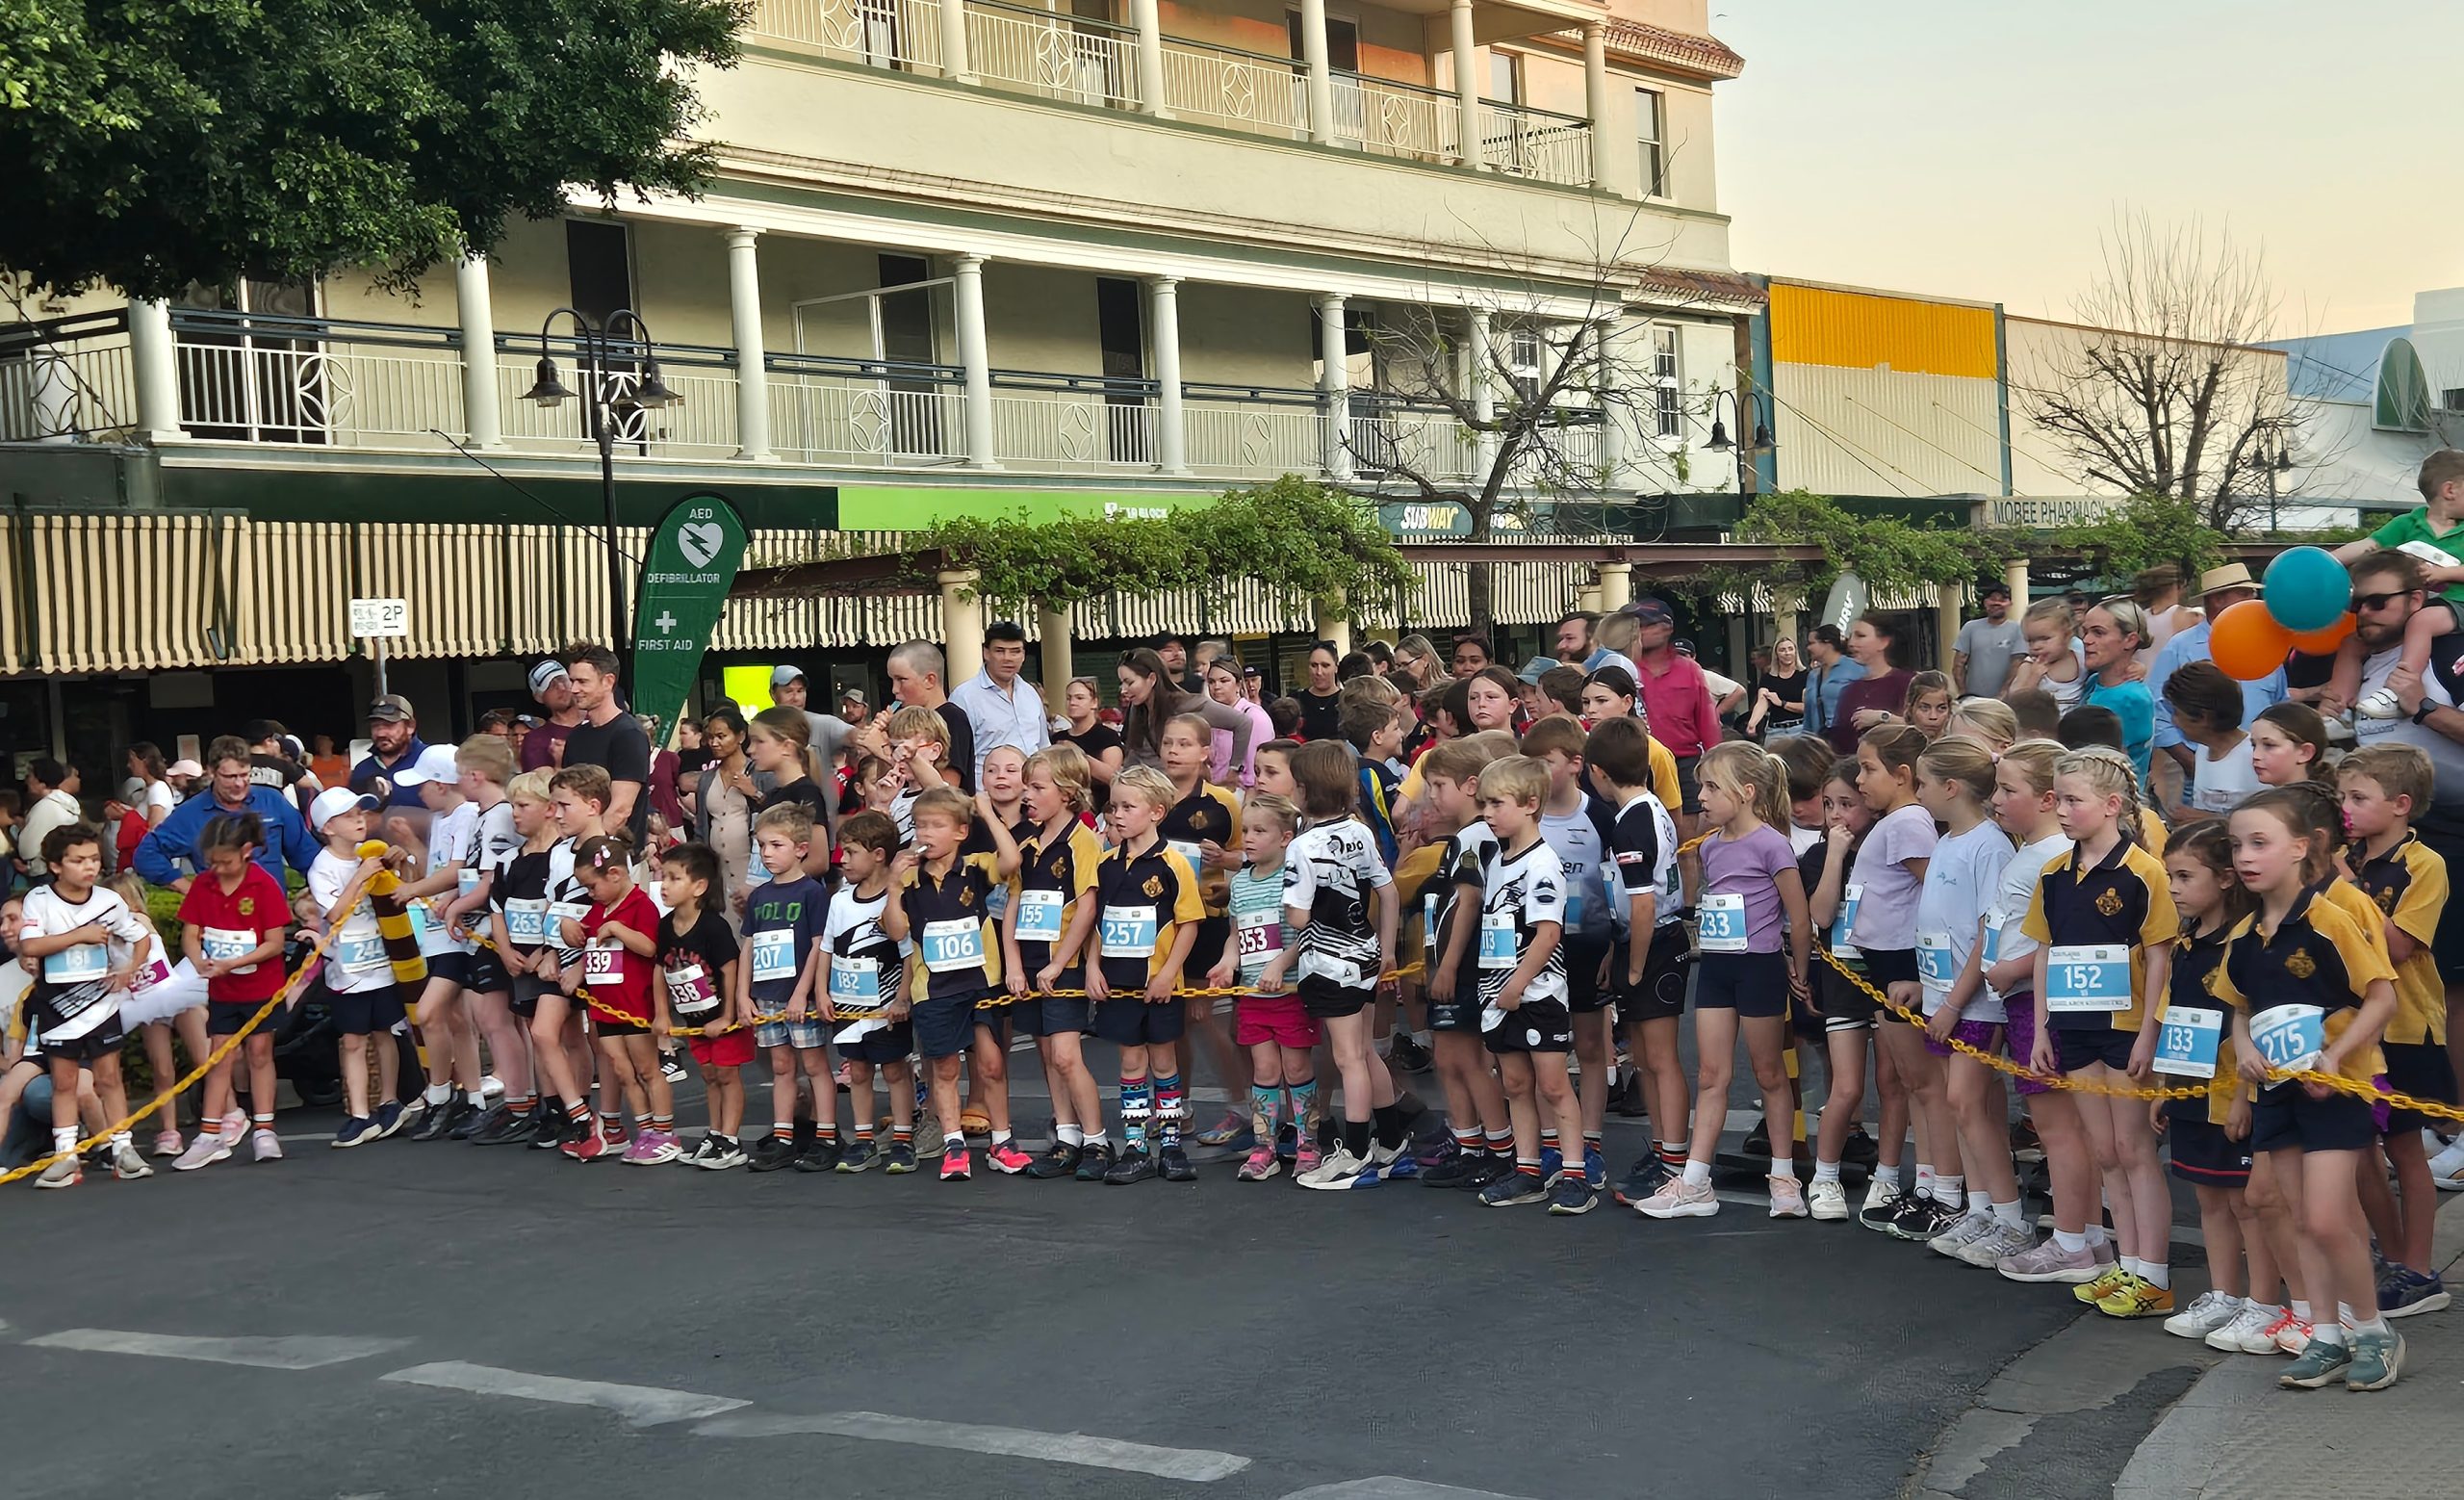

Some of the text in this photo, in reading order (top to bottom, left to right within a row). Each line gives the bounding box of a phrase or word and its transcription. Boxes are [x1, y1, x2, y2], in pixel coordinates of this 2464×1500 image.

[689, 507, 713, 519] AED
[1400, 505, 1458, 530] SUBWAY
[648, 573, 720, 583] DEFIBRILLATOR
[382, 606, 402, 621] 2P
[639, 639, 693, 651] FIRST AID
[754, 902, 802, 921] POLO
[1020, 905, 1042, 924] 155
[511, 913, 541, 933] 263
[1106, 921, 1142, 945] 257
[936, 933, 974, 960] 106
[1239, 926, 1268, 954] 353
[586, 951, 612, 973] 339
[754, 945, 782, 970] 207
[836, 971, 860, 991] 182
[2065, 965, 2103, 989] 152
[2168, 1026, 2194, 1053] 133
[2262, 1022, 2305, 1066] 275
